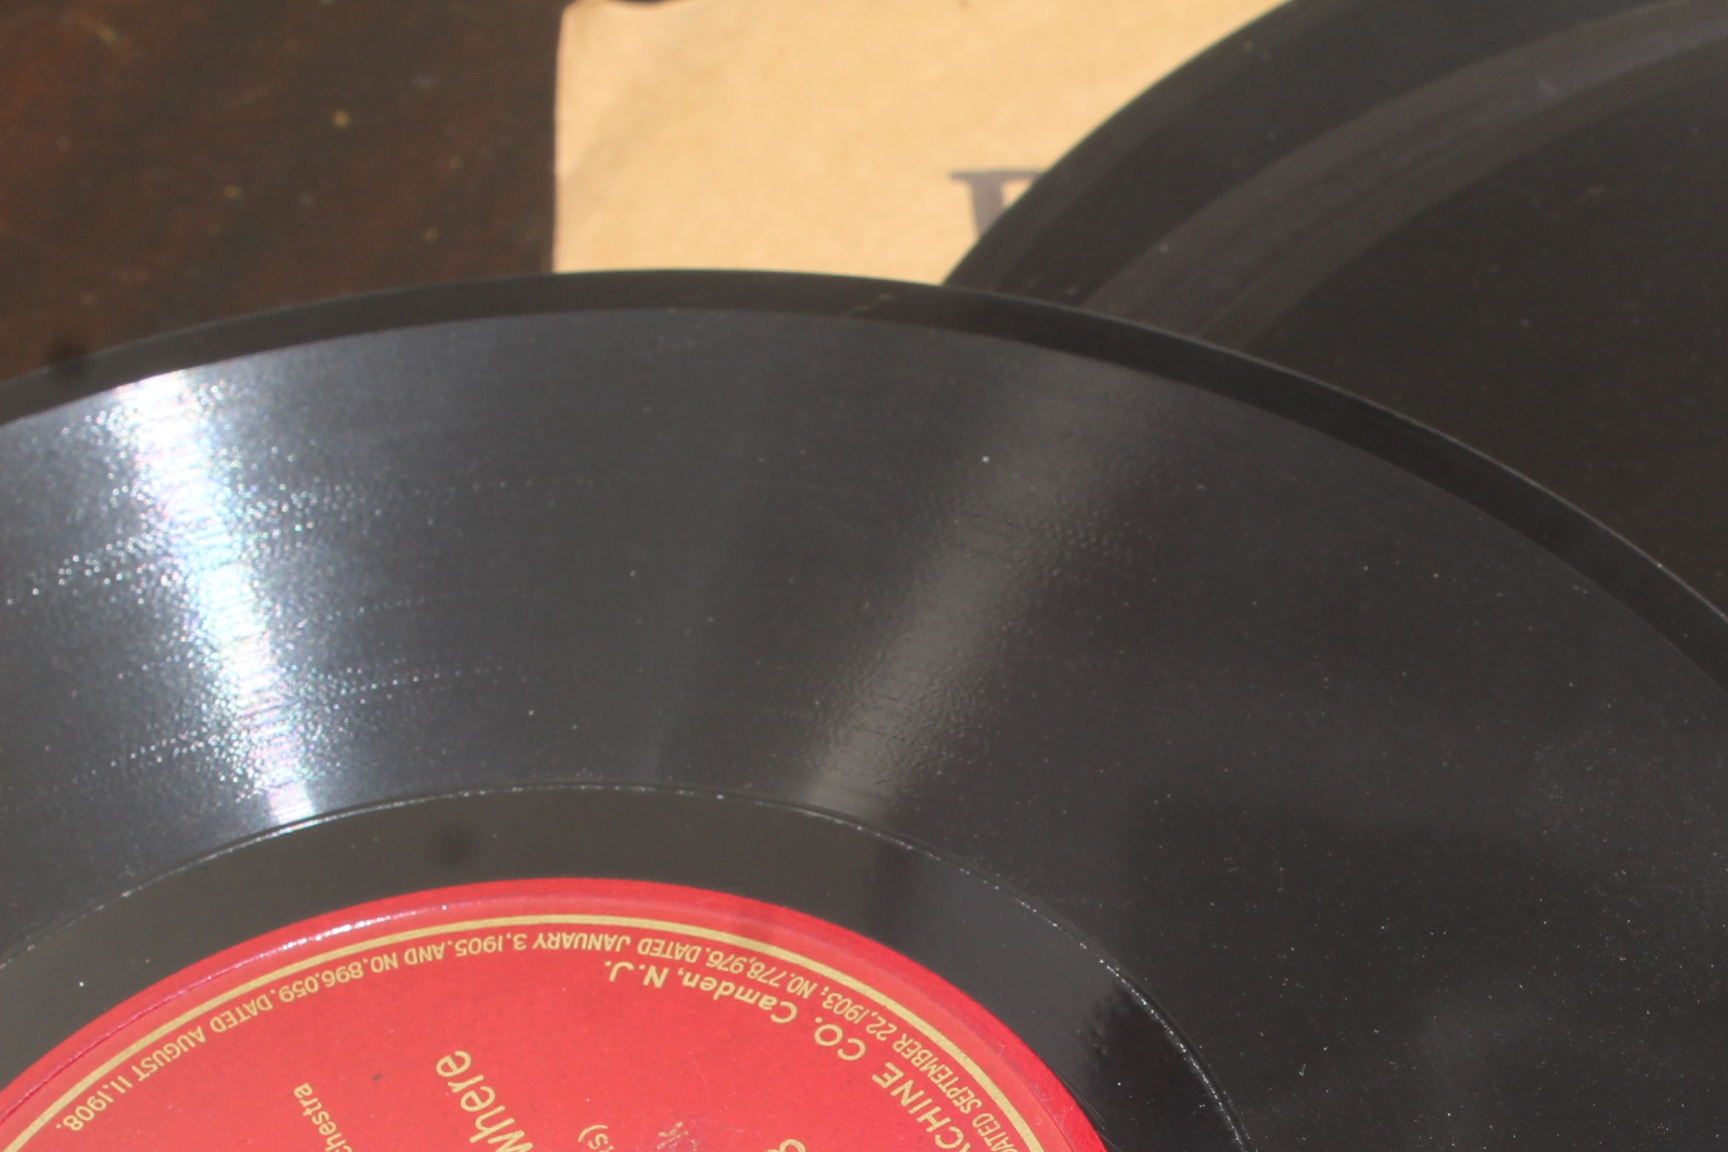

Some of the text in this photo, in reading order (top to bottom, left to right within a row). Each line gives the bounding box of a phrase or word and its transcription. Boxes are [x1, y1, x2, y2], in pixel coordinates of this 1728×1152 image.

[404, 940, 444, 966] AND
[533, 932, 631, 952] JANUARY
[637, 937, 702, 963] DATED
[209, 993, 273, 1033] DATED
[677, 968, 798, 1024] Camden,
[131, 1025, 206, 1082] AUGUST
[814, 1017, 866, 1061] CO.
[892, 1032, 982, 1114] SEPTEMBER
